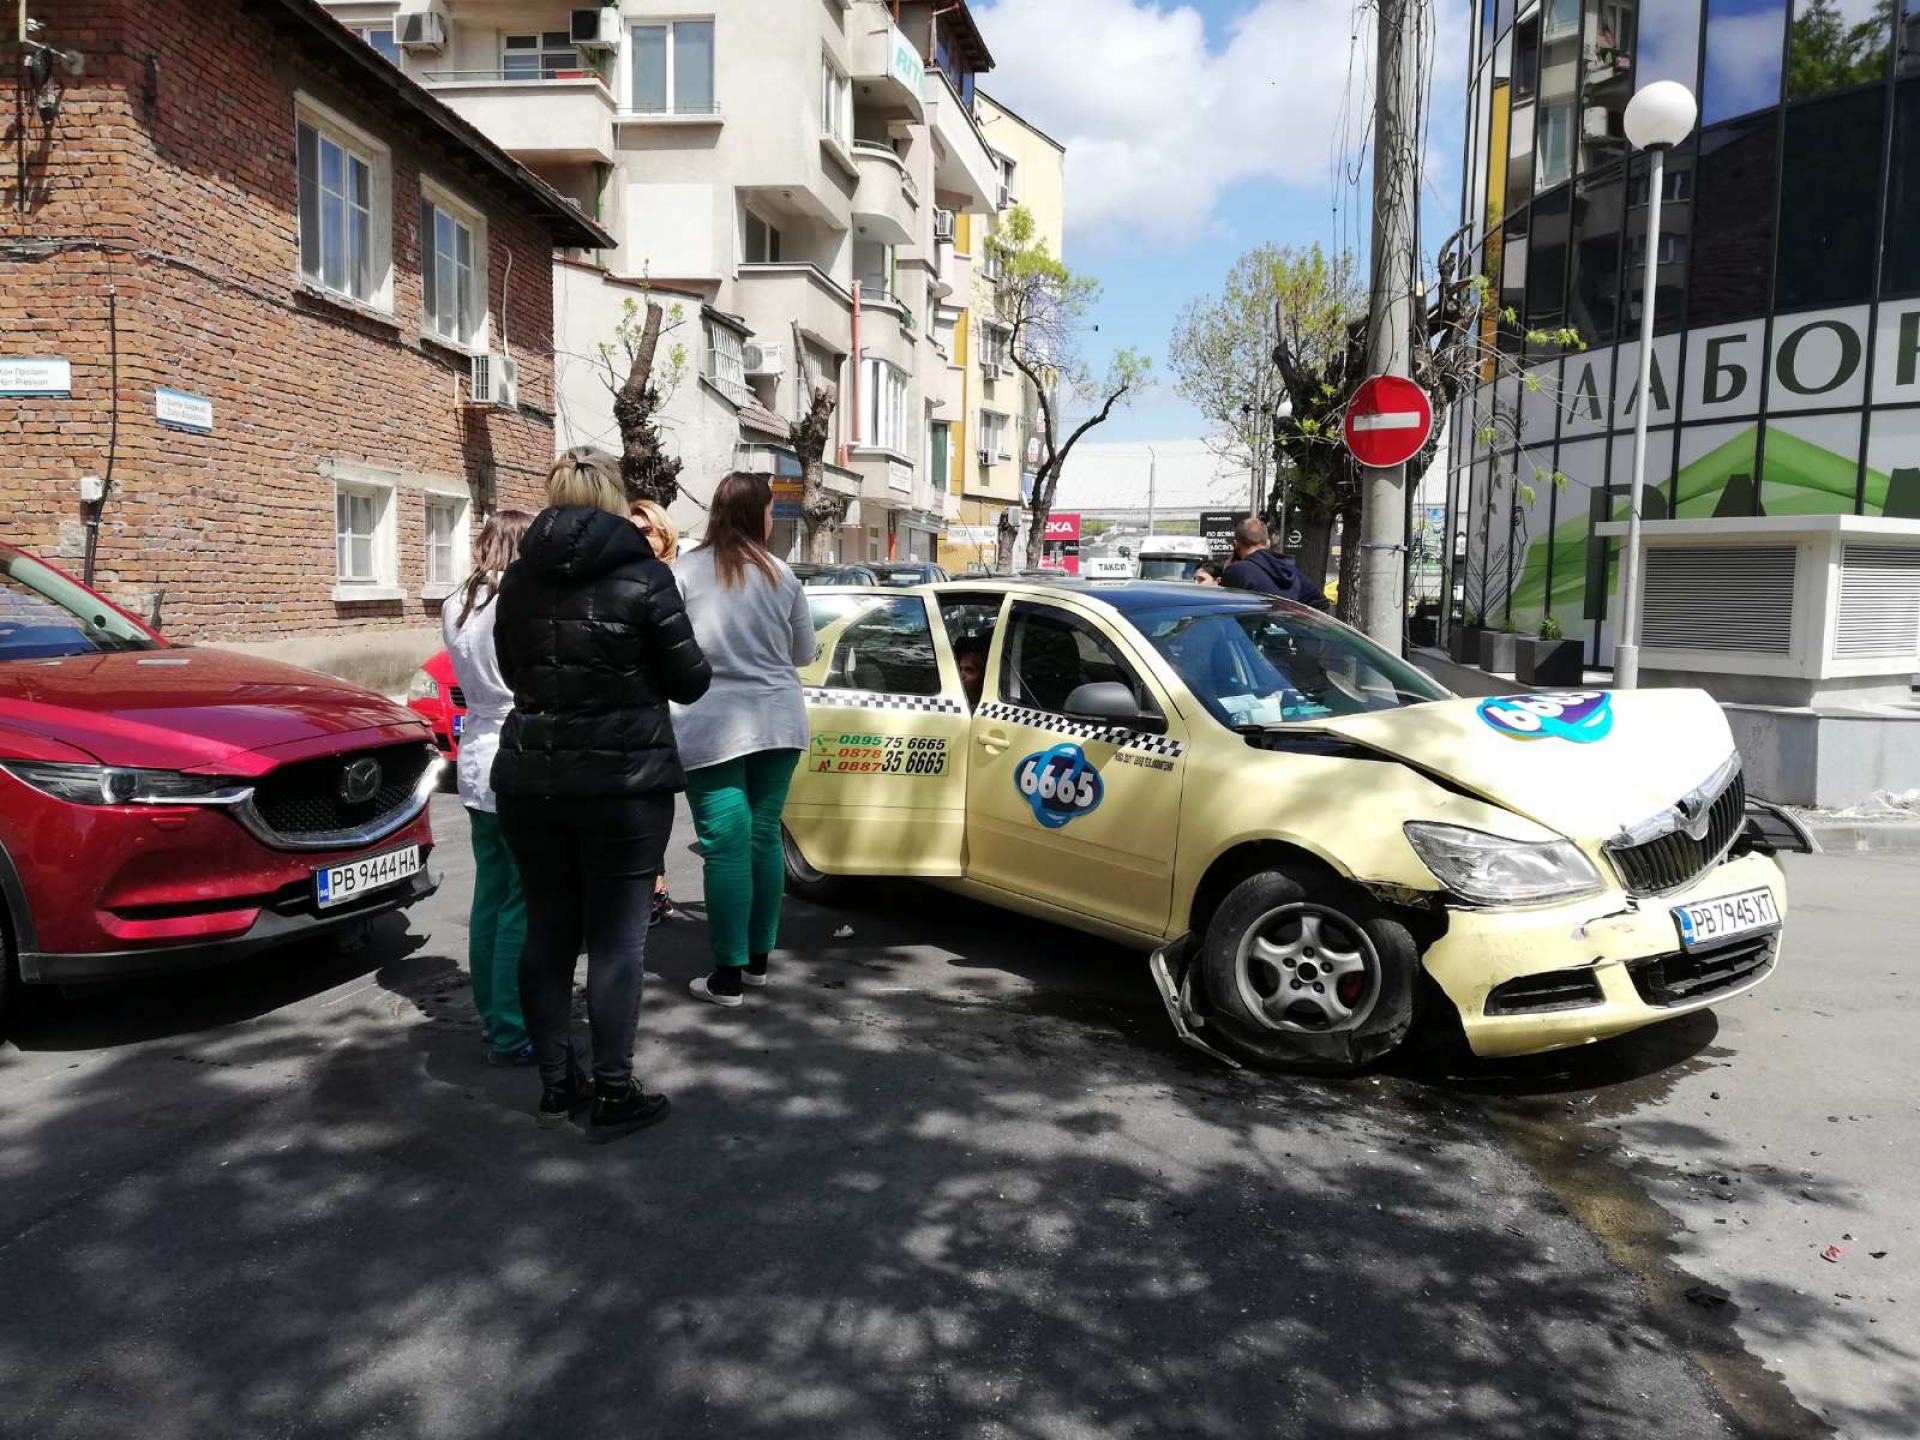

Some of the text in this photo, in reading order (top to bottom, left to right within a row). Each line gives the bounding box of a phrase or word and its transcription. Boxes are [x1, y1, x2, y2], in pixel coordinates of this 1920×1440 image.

[1098, 563, 1127, 571] ТАКСИ
[838, 735, 947, 750] 0895 75 6665
[838, 748, 883, 758] 0878
[881, 750, 947, 774] 35 6665
[837, 761, 883, 772] 0887
[1020, 760, 1095, 808] 6665
[331, 849, 416, 895] PB 9444 HA
[1691, 893, 1774, 936] PB 7945 XT
